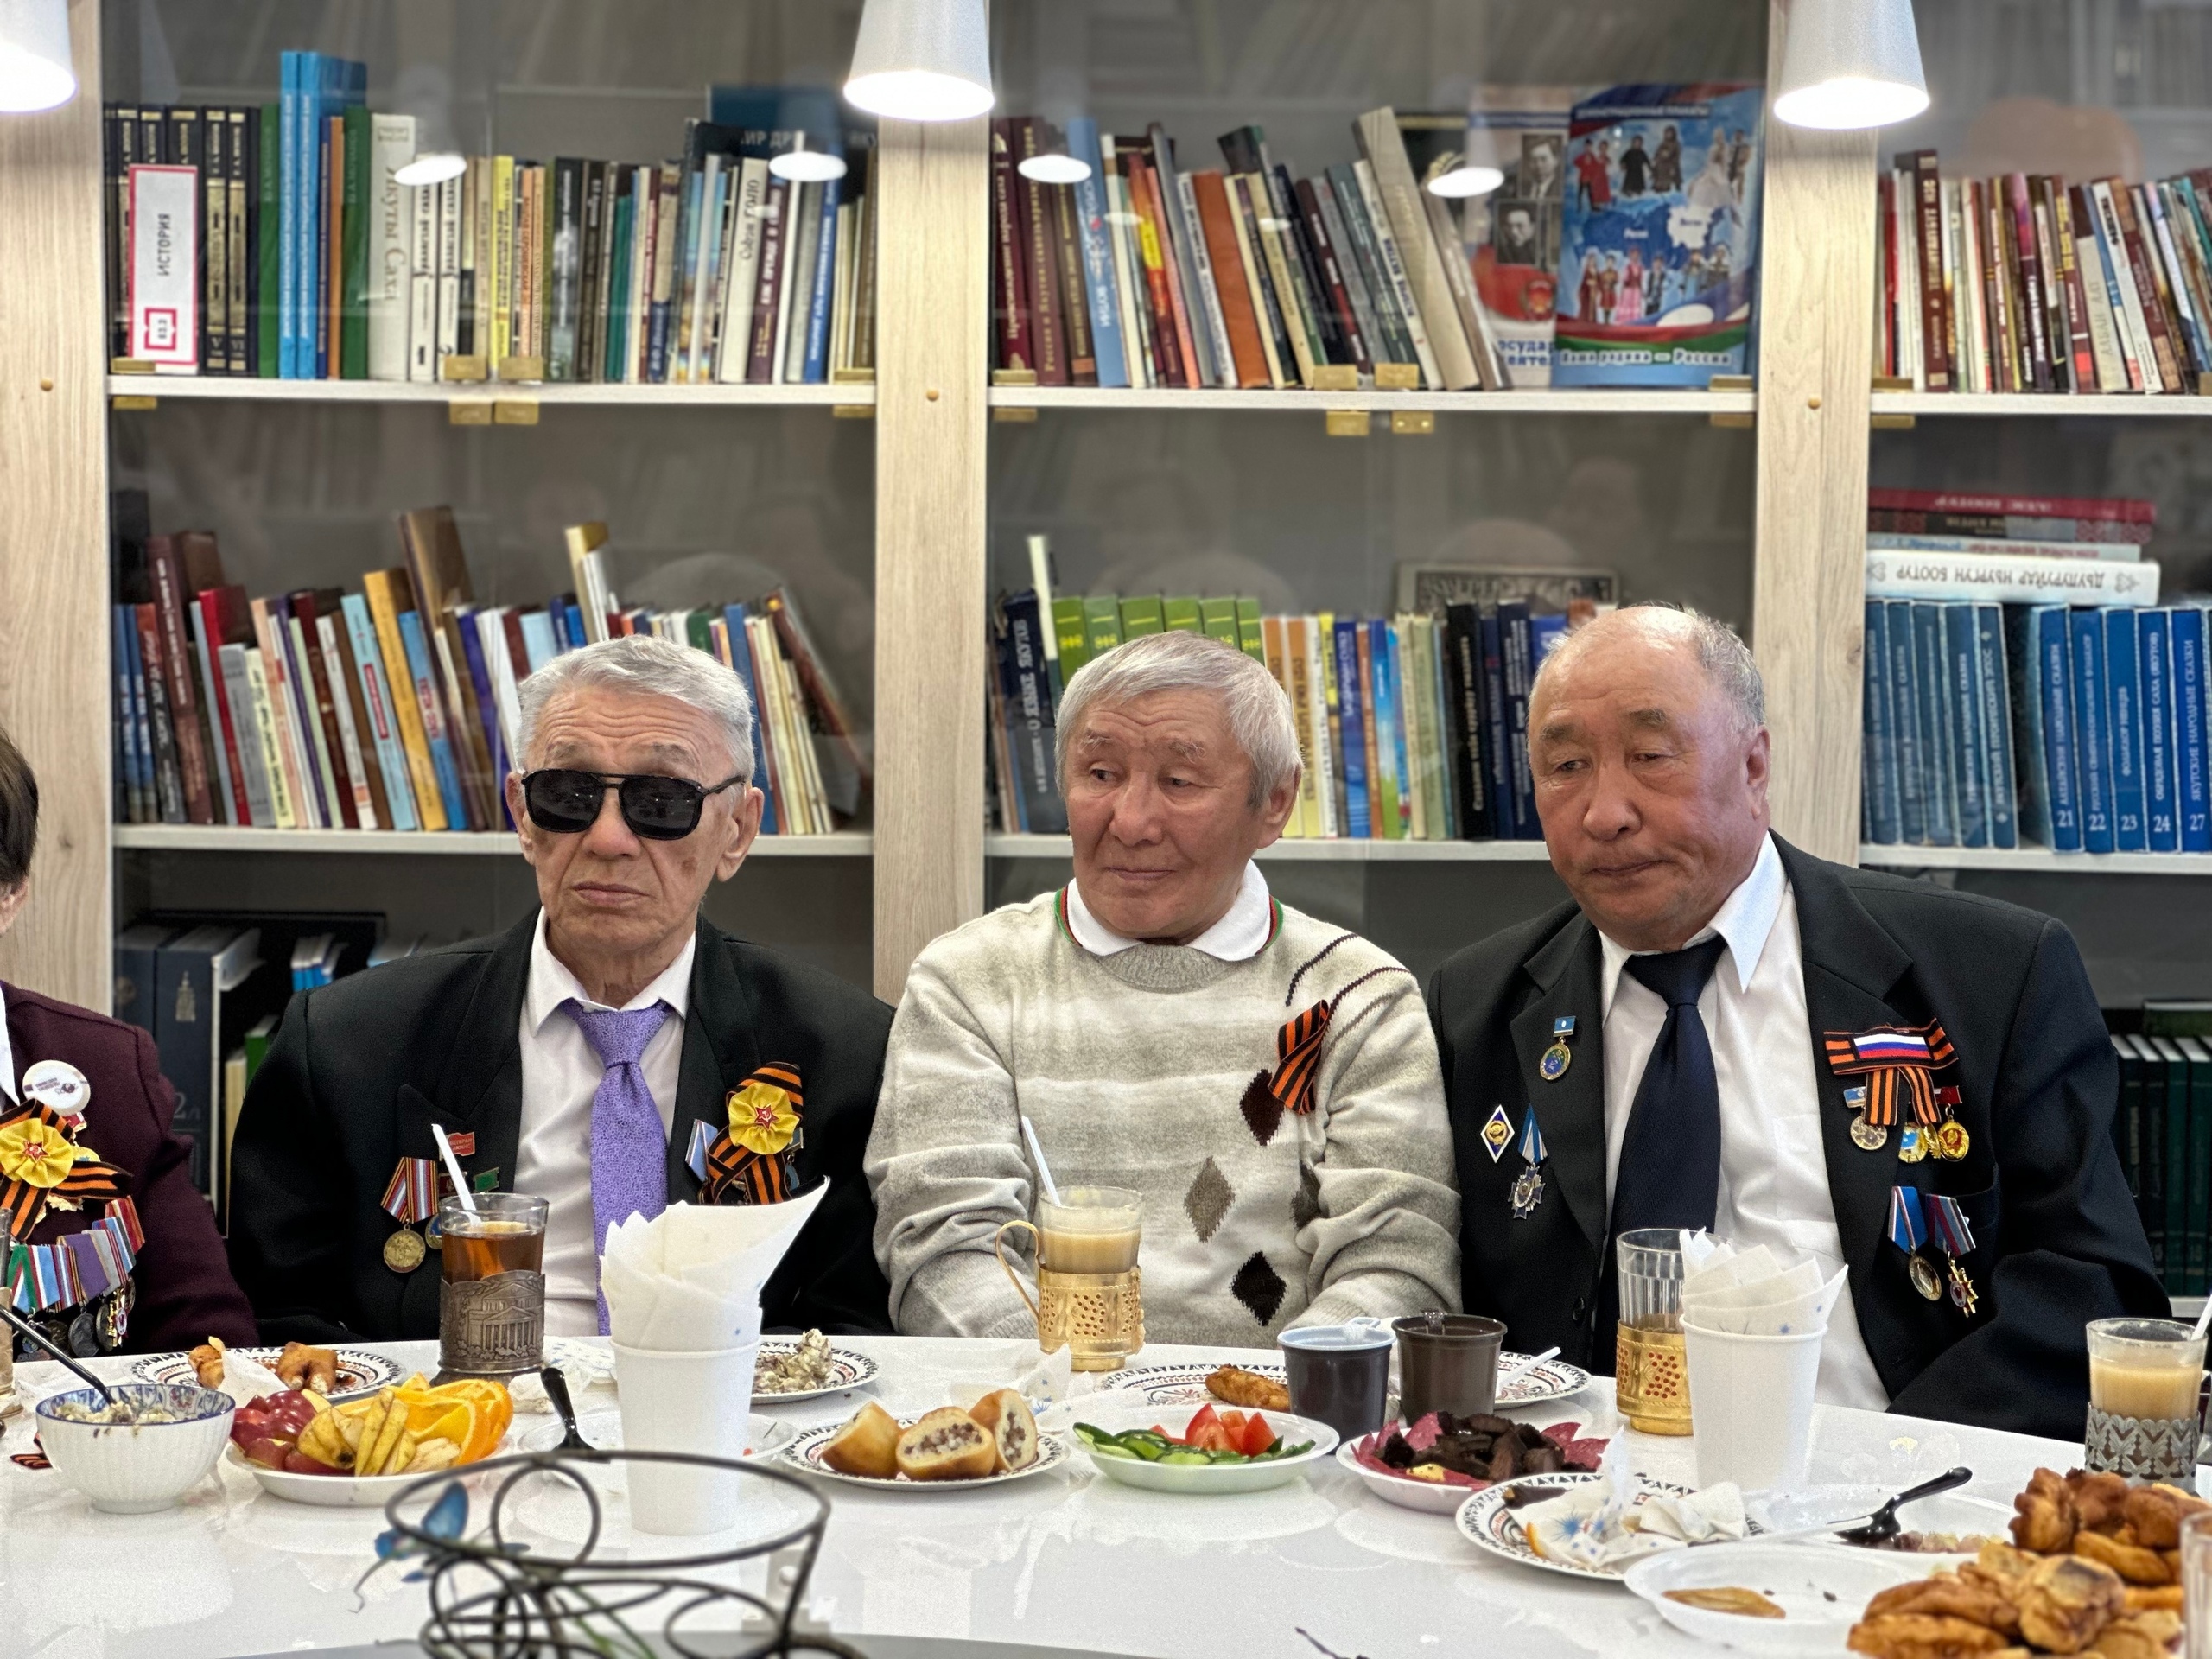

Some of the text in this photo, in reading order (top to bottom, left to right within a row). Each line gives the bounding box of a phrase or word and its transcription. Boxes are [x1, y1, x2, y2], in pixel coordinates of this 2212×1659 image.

[157, 213, 171, 276] ИСТОРИЯ
[385, 248, 407, 301] Саха
[1673, 348, 1731, 365] Россия
[1896, 564, 2105, 589] ДЬУЛУРУЙАР НЬУРГУН БООТУР
[1014, 619, 1032, 668] ЯКУТОВ
[1959, 653, 1968, 690] СКАЗКИ
[1983, 649, 1994, 677] ЭПОС
[1020, 672, 1040, 716] ЯЗЫКЕ
[2051, 644, 2069, 805] АЛТАЙСКИЕ НАРОДНЫЕ СКАЗКИ
[2149, 632, 2165, 800] ОБРЯДОВАЯ ПОЭЗИЯ САХА (ЯКУТОВ)
[2183, 639, 2202, 800] ЯКУТСКИЕ НАРОДНЫЕ СКАЗКИ
[2058, 810, 2074, 827] 21
[2088, 814, 2106, 831] 22
[2121, 814, 2138, 831] 23
[2153, 815, 2171, 832] 24
[2190, 814, 2205, 831] 27
